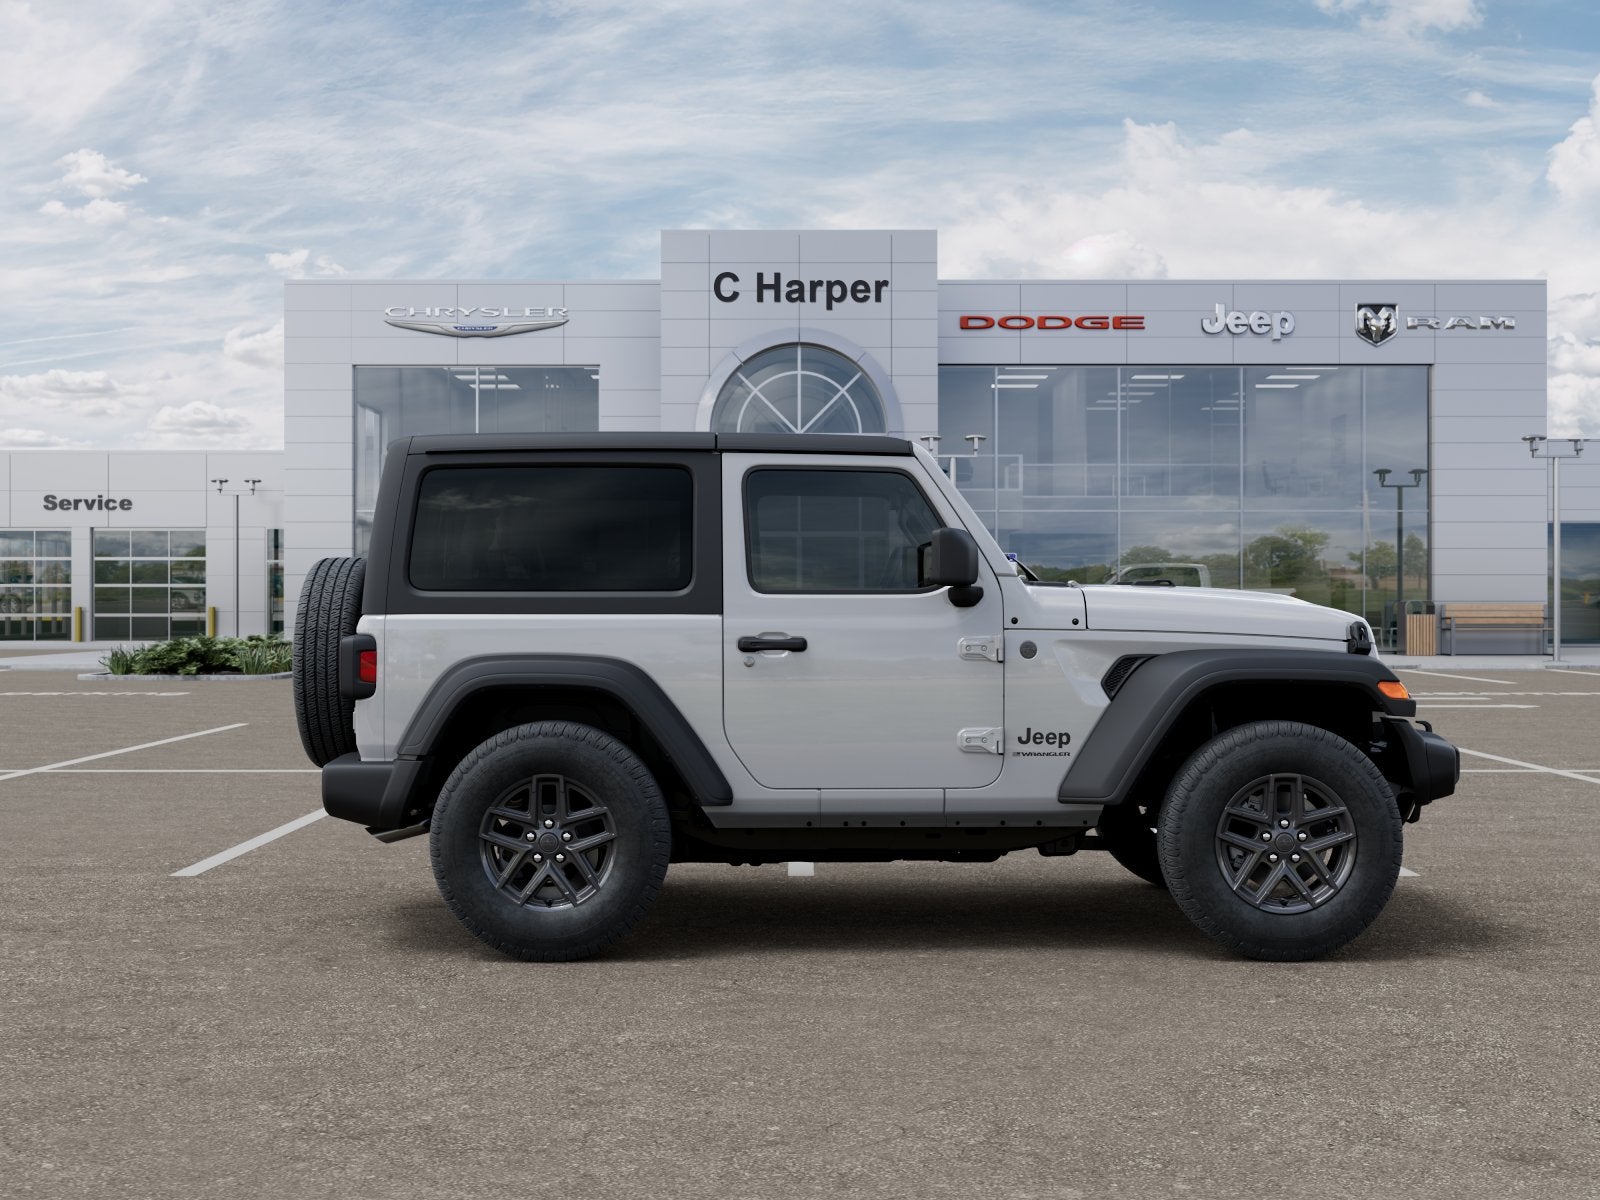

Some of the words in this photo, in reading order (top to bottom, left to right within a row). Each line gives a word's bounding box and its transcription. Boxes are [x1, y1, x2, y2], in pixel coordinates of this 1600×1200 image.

[714, 271, 740, 303] C
[756, 272, 890, 311] Harper
[384, 306, 569, 317] CHRYSLER
[960, 316, 1145, 330] DODGE
[1201, 303, 1295, 341] Jeep
[1406, 316, 1516, 330] RAM
[43, 494, 133, 511] Service
[1017, 727, 1071, 748] Jeep
